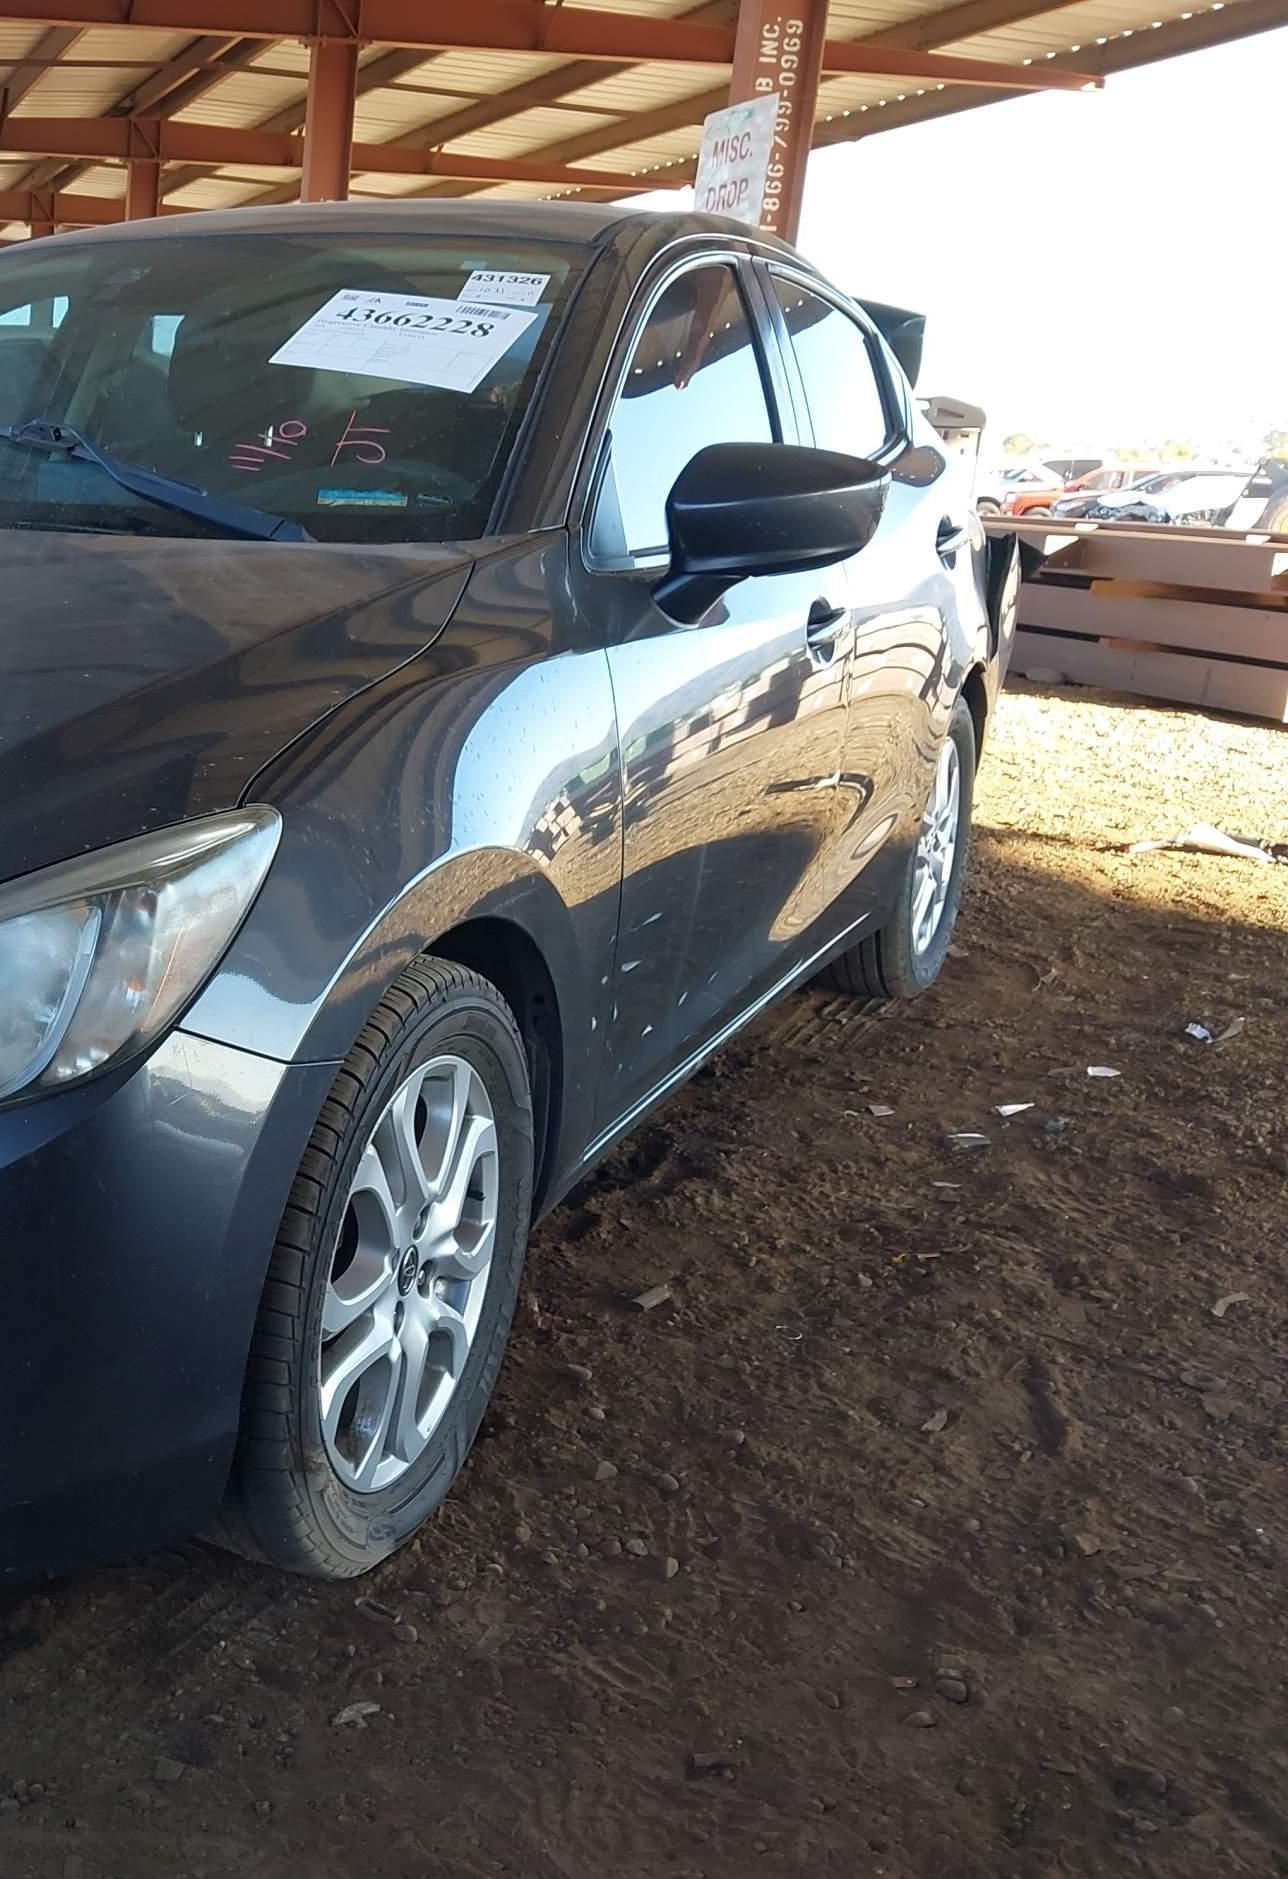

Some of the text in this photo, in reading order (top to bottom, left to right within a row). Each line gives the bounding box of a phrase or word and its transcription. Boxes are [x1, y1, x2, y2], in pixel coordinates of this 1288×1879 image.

[759, 16, 782, 63] INC.
[711, 132, 753, 169] MISC.
[705, 178, 749, 212] DROP
[471, 274, 543, 286] 431326
[335, 306, 495, 338] 43662228
